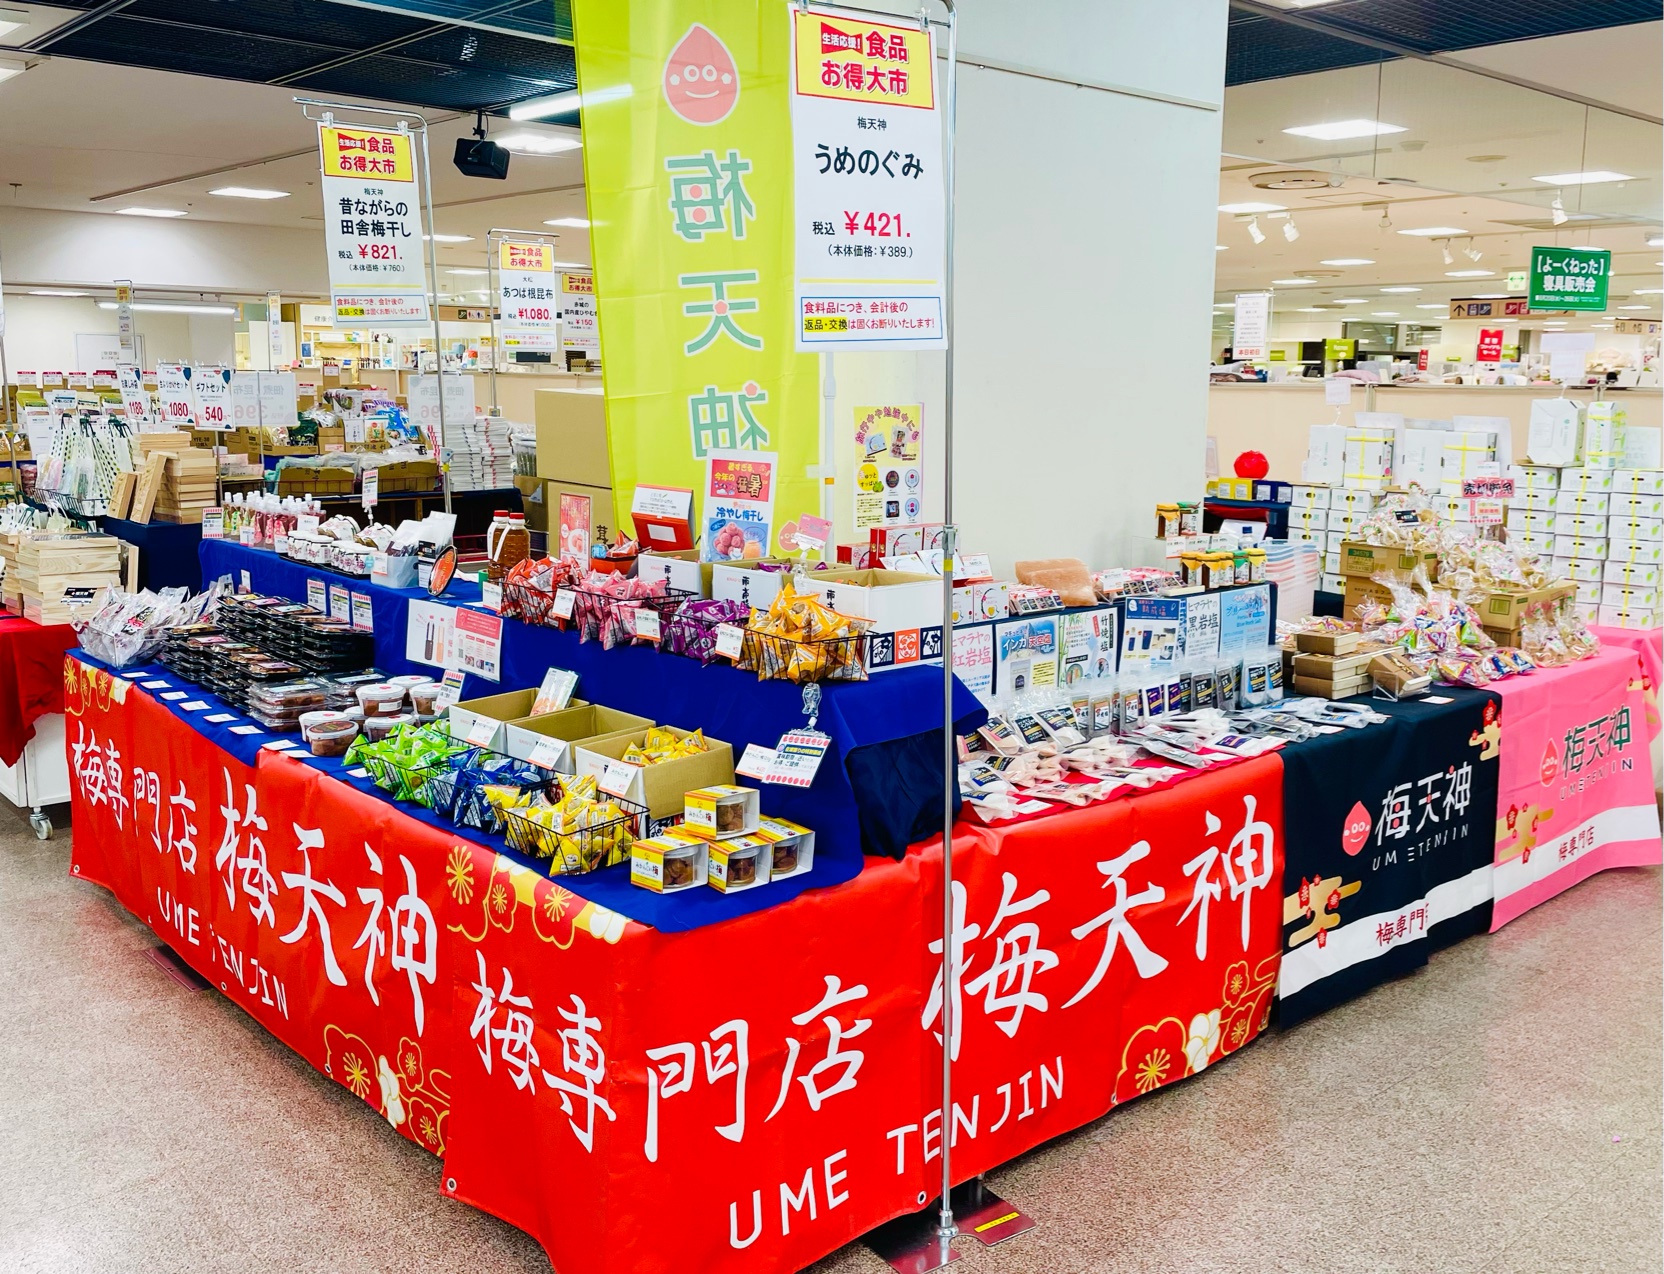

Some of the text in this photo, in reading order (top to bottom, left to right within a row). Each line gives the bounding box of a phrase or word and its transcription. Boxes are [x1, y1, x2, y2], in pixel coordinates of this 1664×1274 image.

[865, 31, 909, 62] 食品
[820, 60, 909, 95] お得大市
[857, 116, 888, 131] 梅天神
[366, 137, 396, 154] 食品
[339, 154, 396, 175] お得大市
[814, 143, 925, 179] うめのぐみ
[363, 187, 384, 196] 梅天神
[338, 197, 409, 217] 昔ながらの
[340, 218, 412, 238] 田舎梅干し
[812, 211, 912, 238] 税込 ¥421.
[338, 250, 353, 259] 税込
[803, 301, 909, 315] 食料品につき、会計後の
[168, 402, 190, 417] 1080
[205, 406, 223, 422] 540
[716, 506, 764, 522] 冷やし梅干し
[1562, 703, 1632, 779] 梅天神
[1374, 760, 1473, 848] 梅天神
[1558, 825, 1595, 864] 梅専門店
[71, 720, 439, 1039] 梅専門店 梅天神
[157, 886, 201, 947] UME
[1376, 902, 1430, 947] 梅専門
[469, 794, 1277, 1165] 梅専門店 梅天神
[728, 1055, 1066, 1252] UME TENJIN
